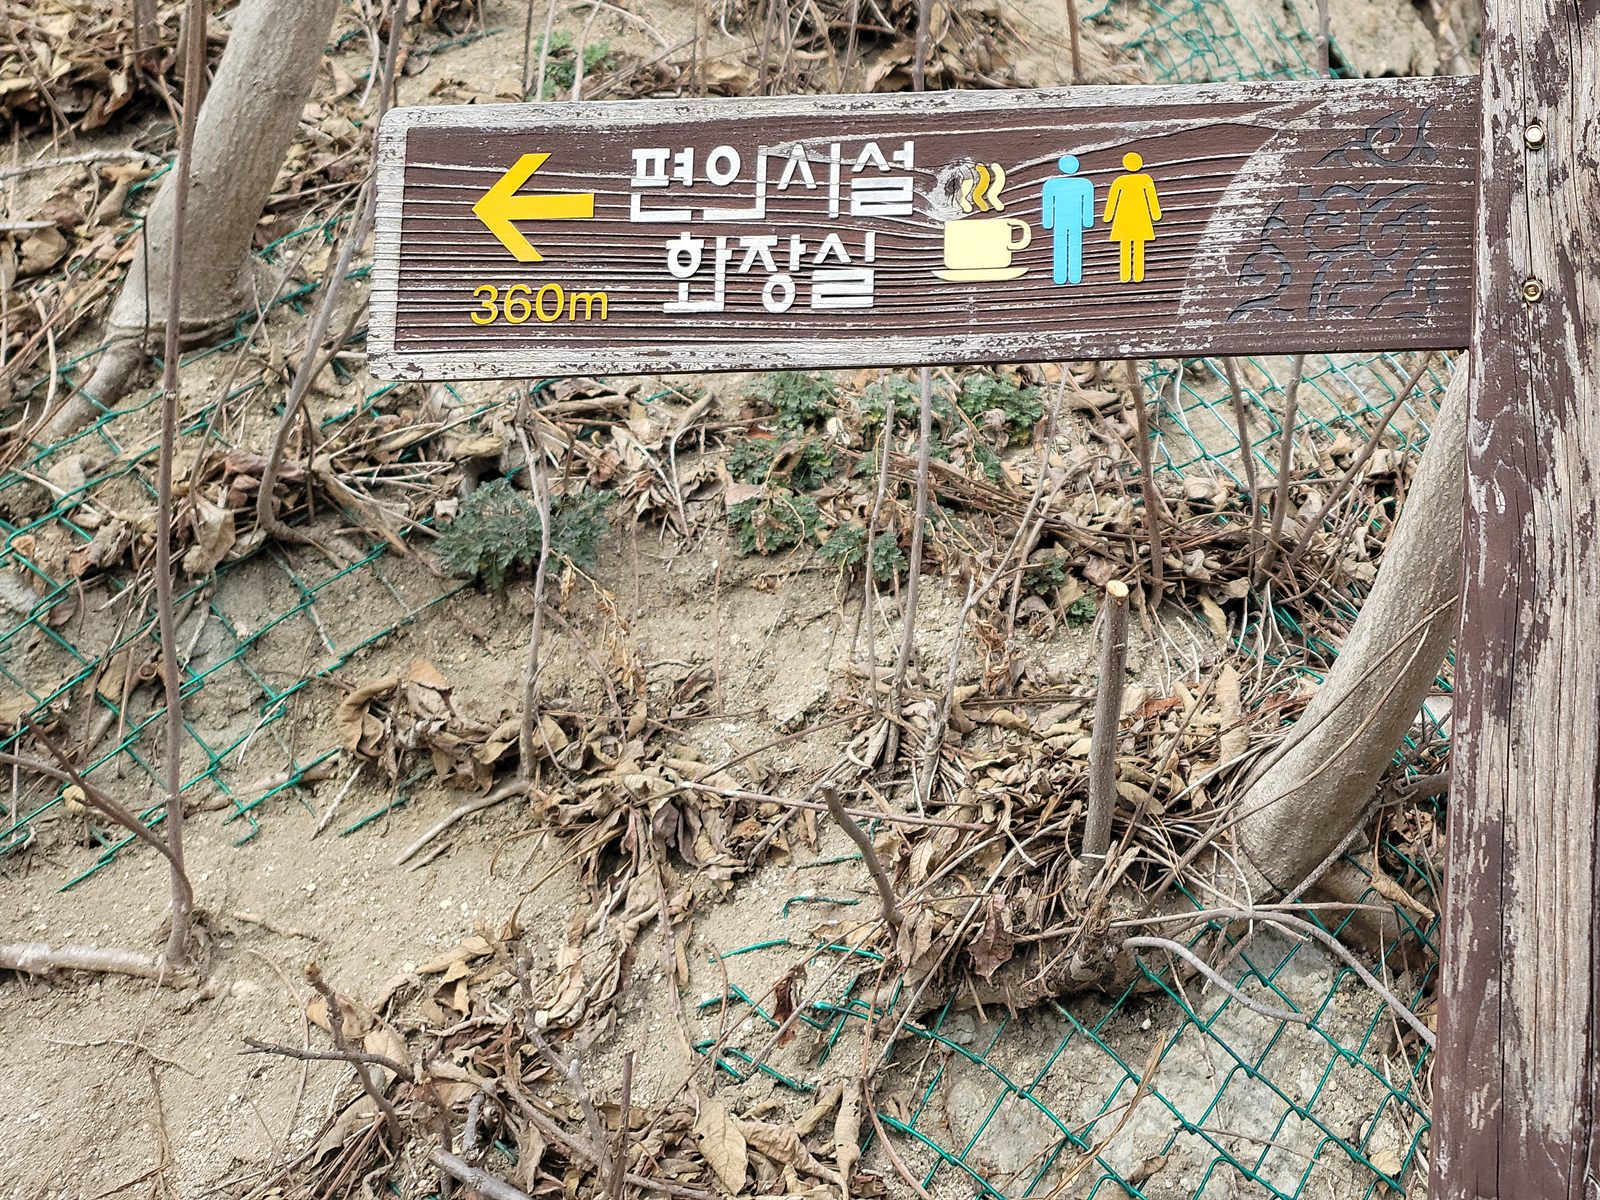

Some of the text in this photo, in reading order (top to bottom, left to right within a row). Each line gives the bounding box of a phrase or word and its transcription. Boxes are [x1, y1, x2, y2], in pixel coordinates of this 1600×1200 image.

[630, 141, 916, 223] 편의시설
[469, 283, 610, 326] 360m
[662, 231, 877, 315] 화장실
